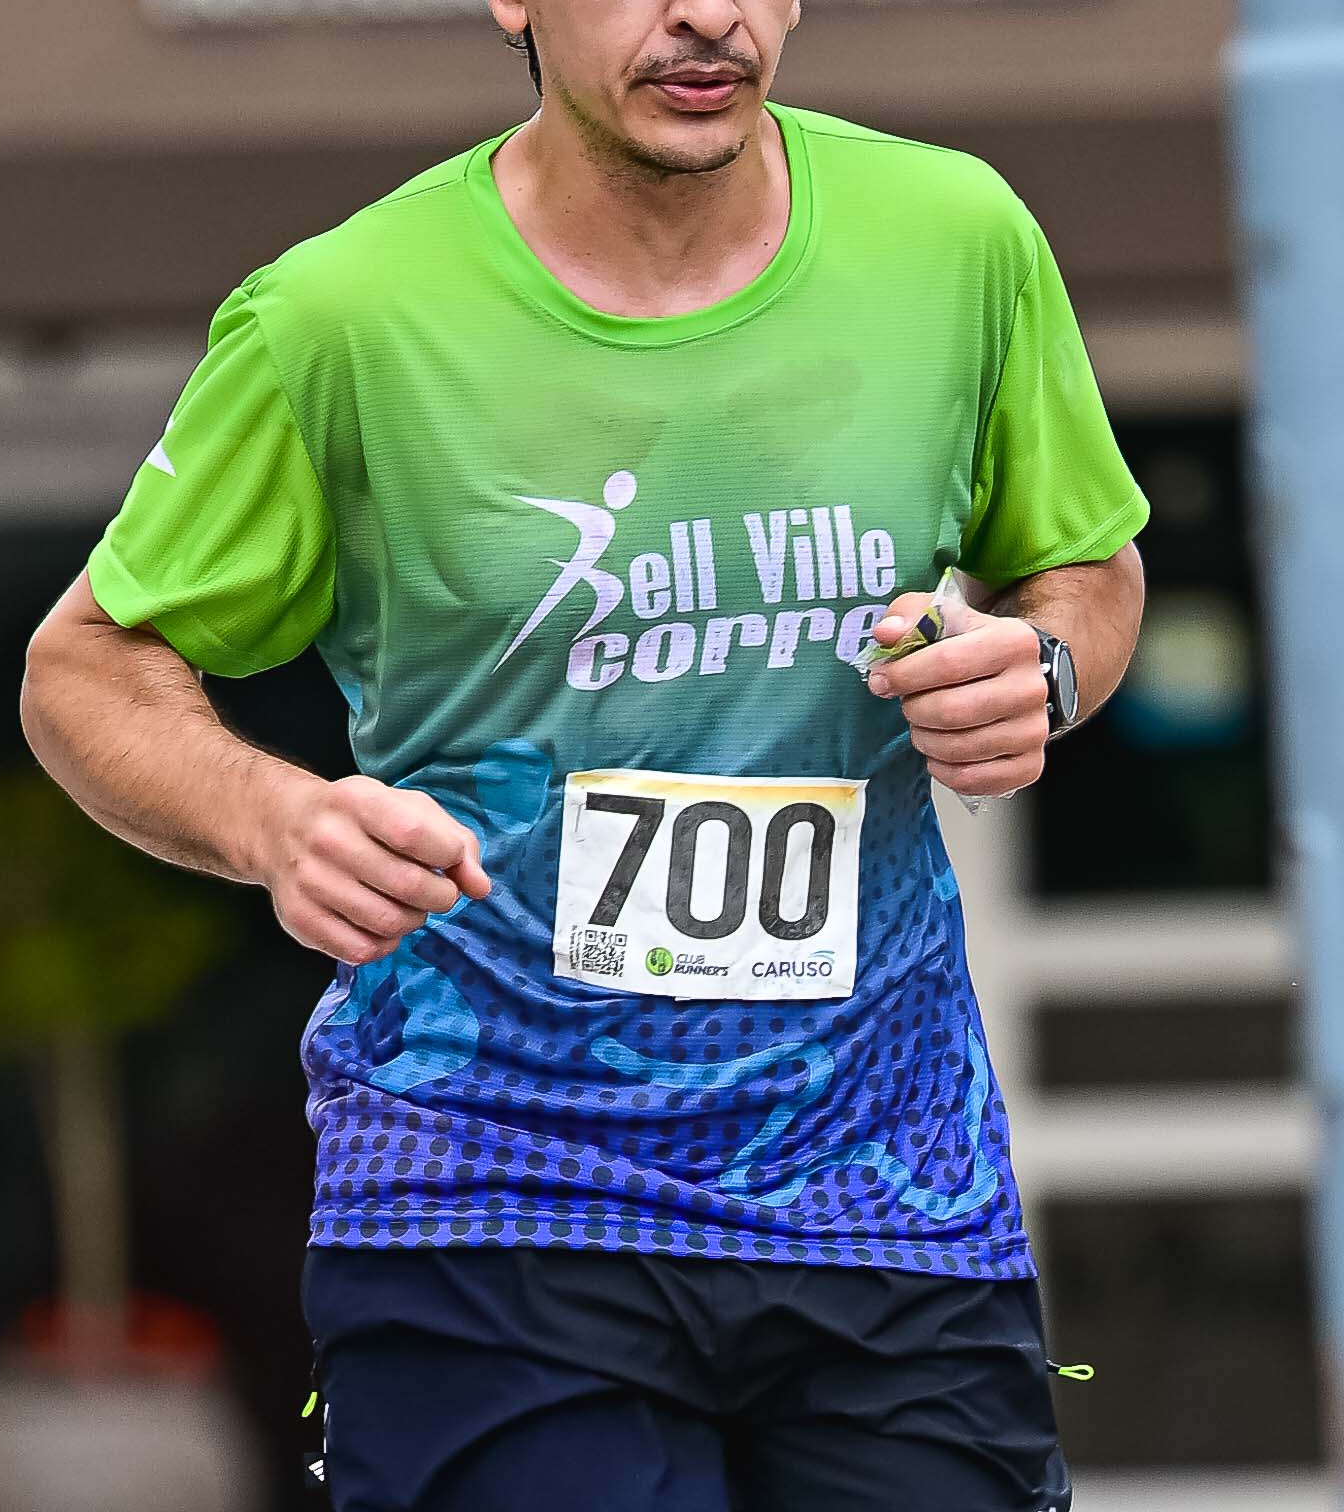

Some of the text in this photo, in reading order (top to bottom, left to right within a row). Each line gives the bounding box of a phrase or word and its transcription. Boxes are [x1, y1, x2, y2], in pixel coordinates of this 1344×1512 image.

[743, 504, 897, 604] Ville
[566, 604, 890, 691] corre
[586, 792, 836, 941] 700
[752, 961, 833, 978] CARUSO
